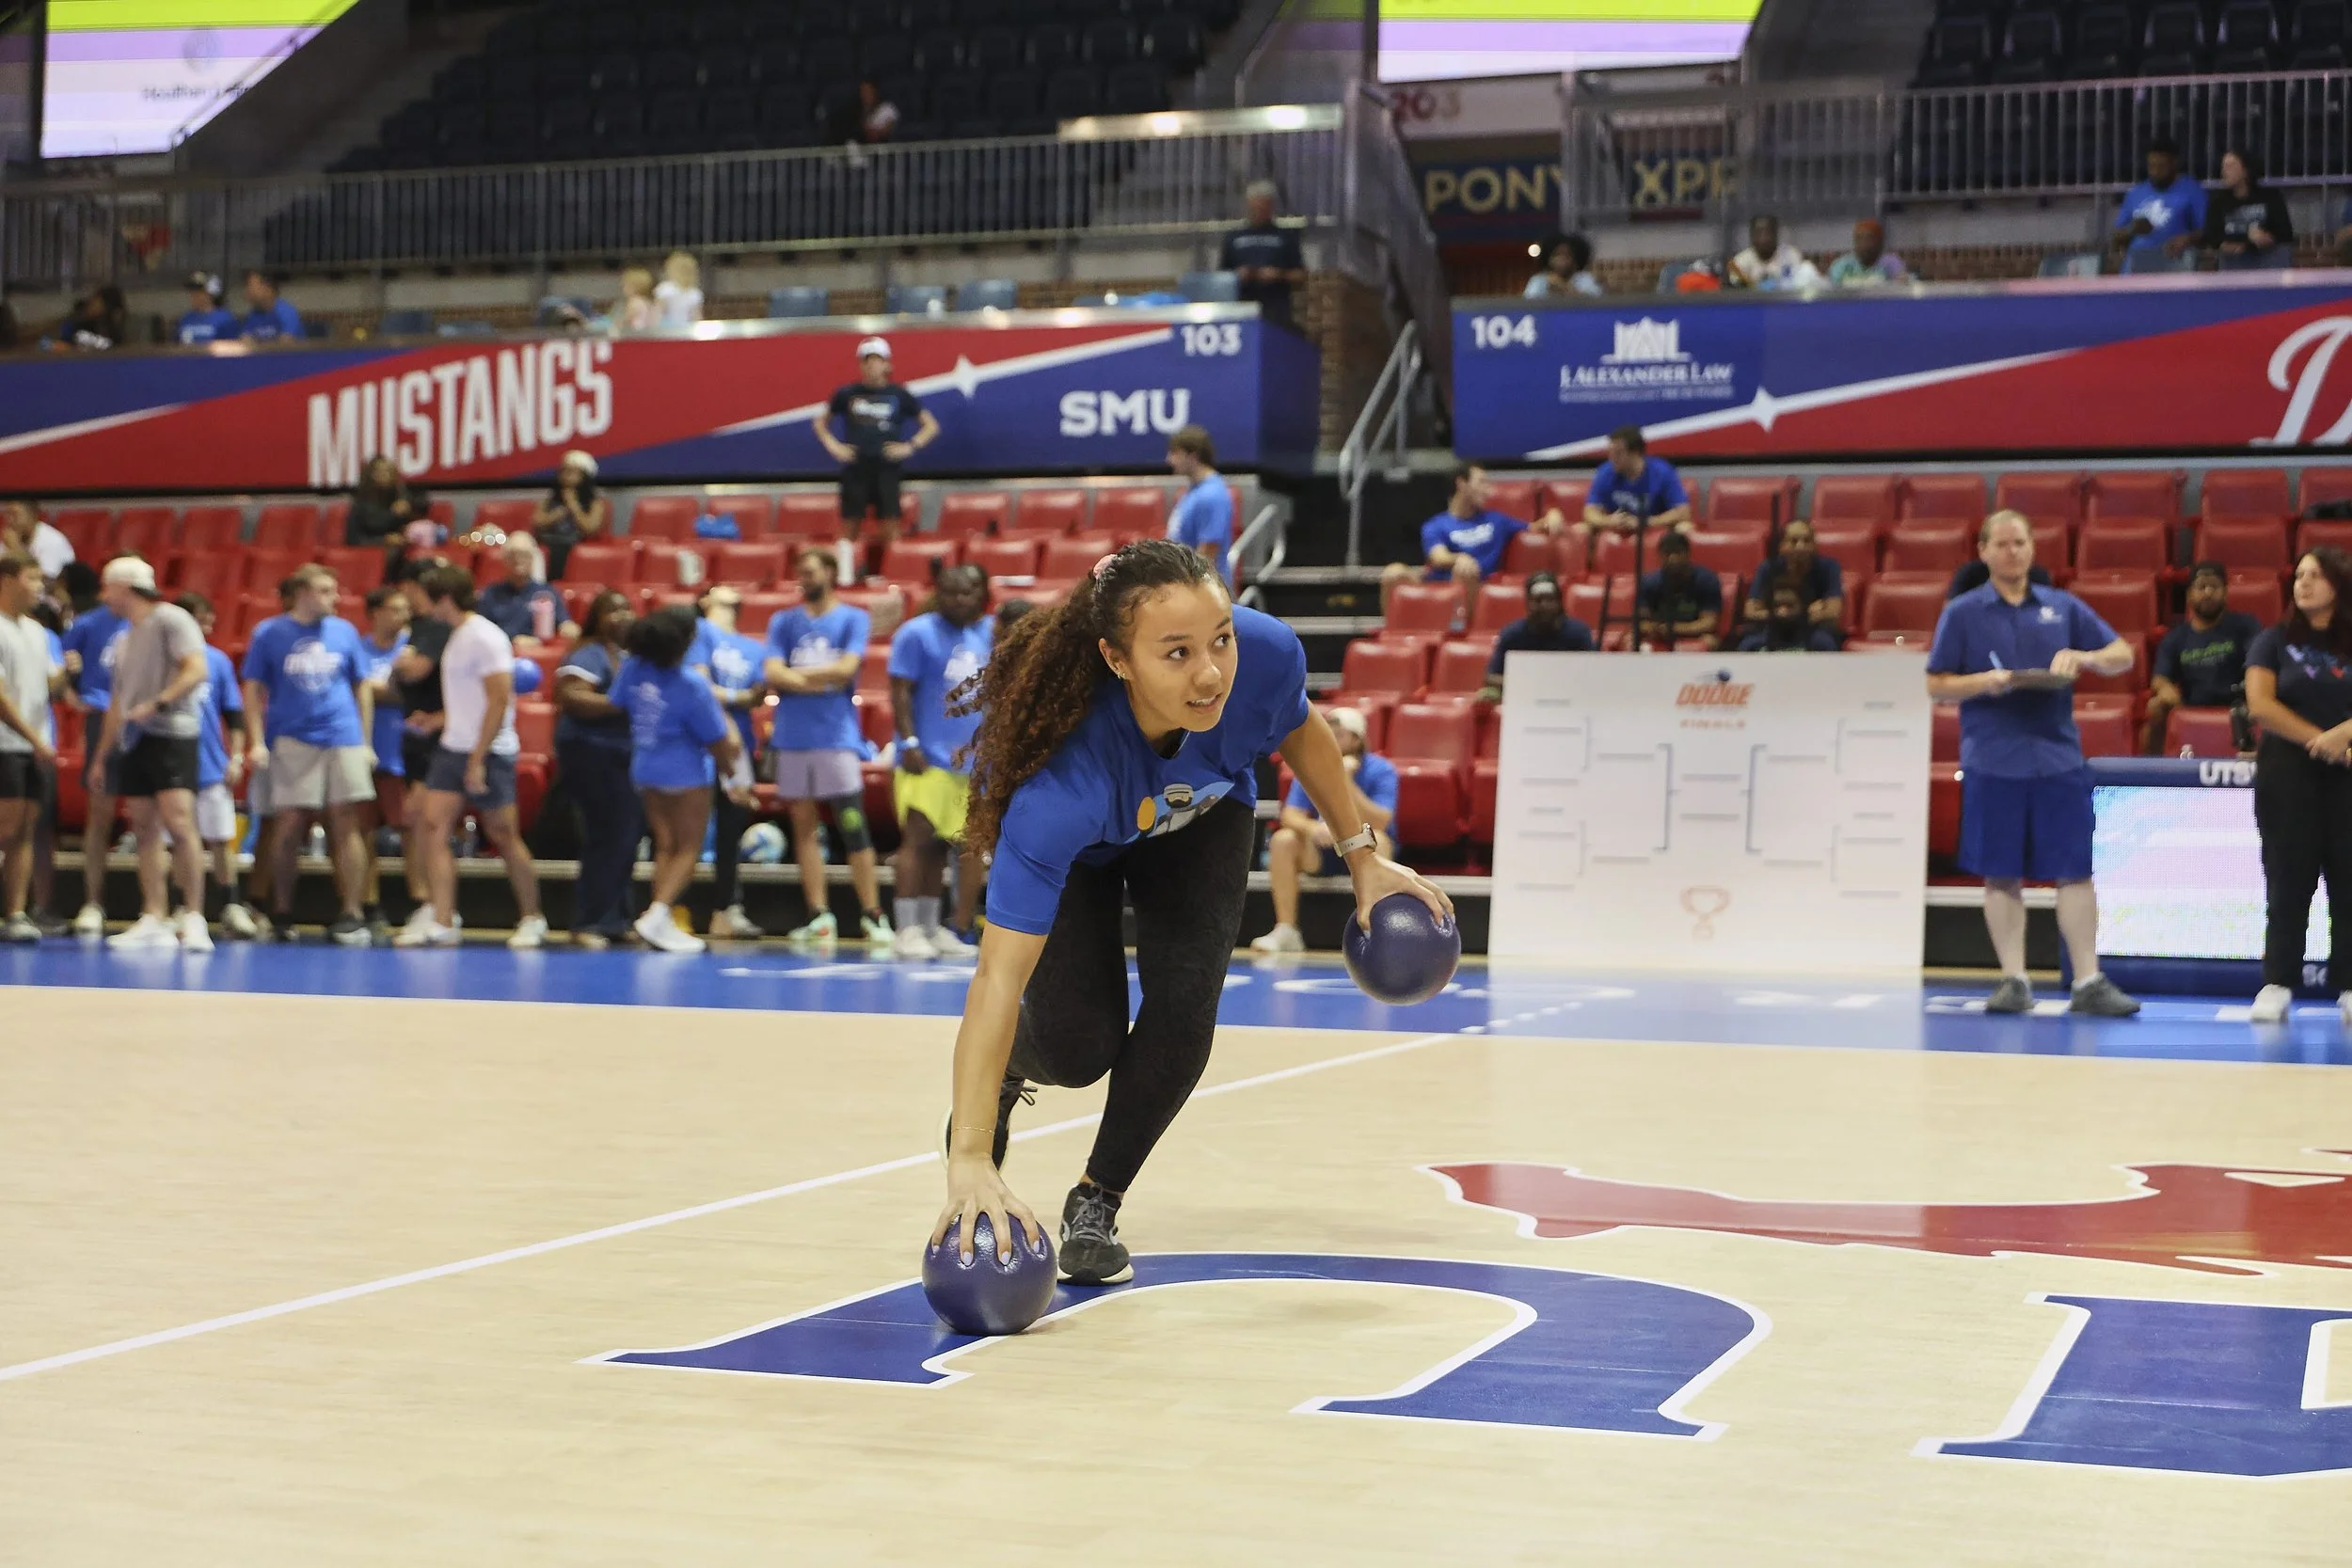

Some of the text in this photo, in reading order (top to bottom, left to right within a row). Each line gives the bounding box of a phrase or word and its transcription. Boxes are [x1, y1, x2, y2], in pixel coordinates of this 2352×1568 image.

[1181, 324, 1242, 356] 103
[1470, 315, 1538, 348] 104
[307, 339, 612, 488] MUSTANGS
[1059, 388, 1192, 436] SMU
[1676, 683, 1755, 705] DODGE
